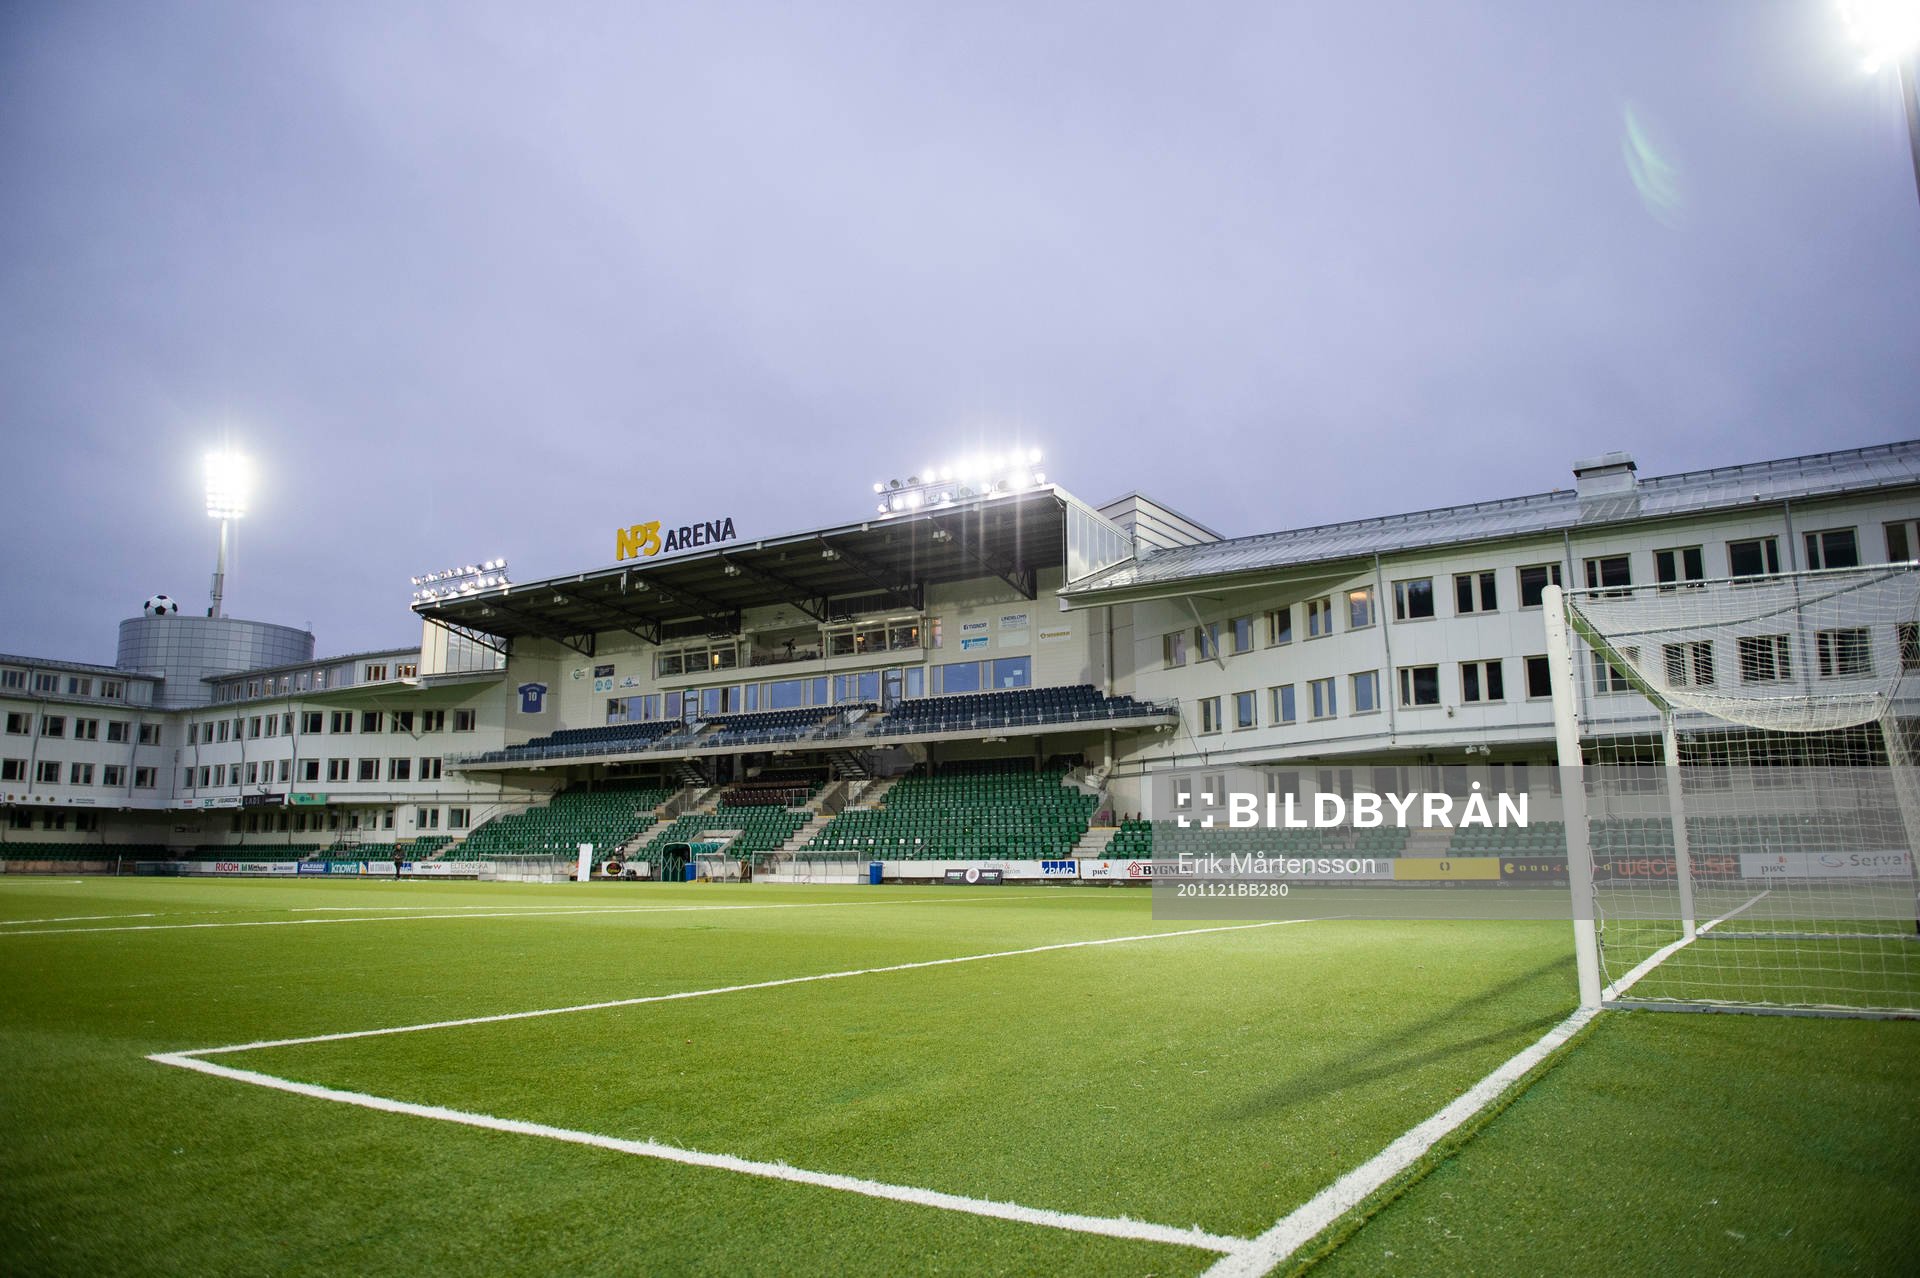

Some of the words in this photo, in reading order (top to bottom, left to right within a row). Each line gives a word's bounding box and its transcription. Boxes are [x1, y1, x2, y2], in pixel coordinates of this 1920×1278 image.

[617, 520, 661, 561] NP3
[664, 517, 737, 552] ARENA
[528, 691, 537, 701] 10
[215, 862, 239, 871] RICOH
[331, 862, 358, 873] knowit
[1042, 863, 1076, 874] KPMG
[1143, 865, 1190, 875] BYGMA
[1617, 857, 1736, 876] wecal.se
